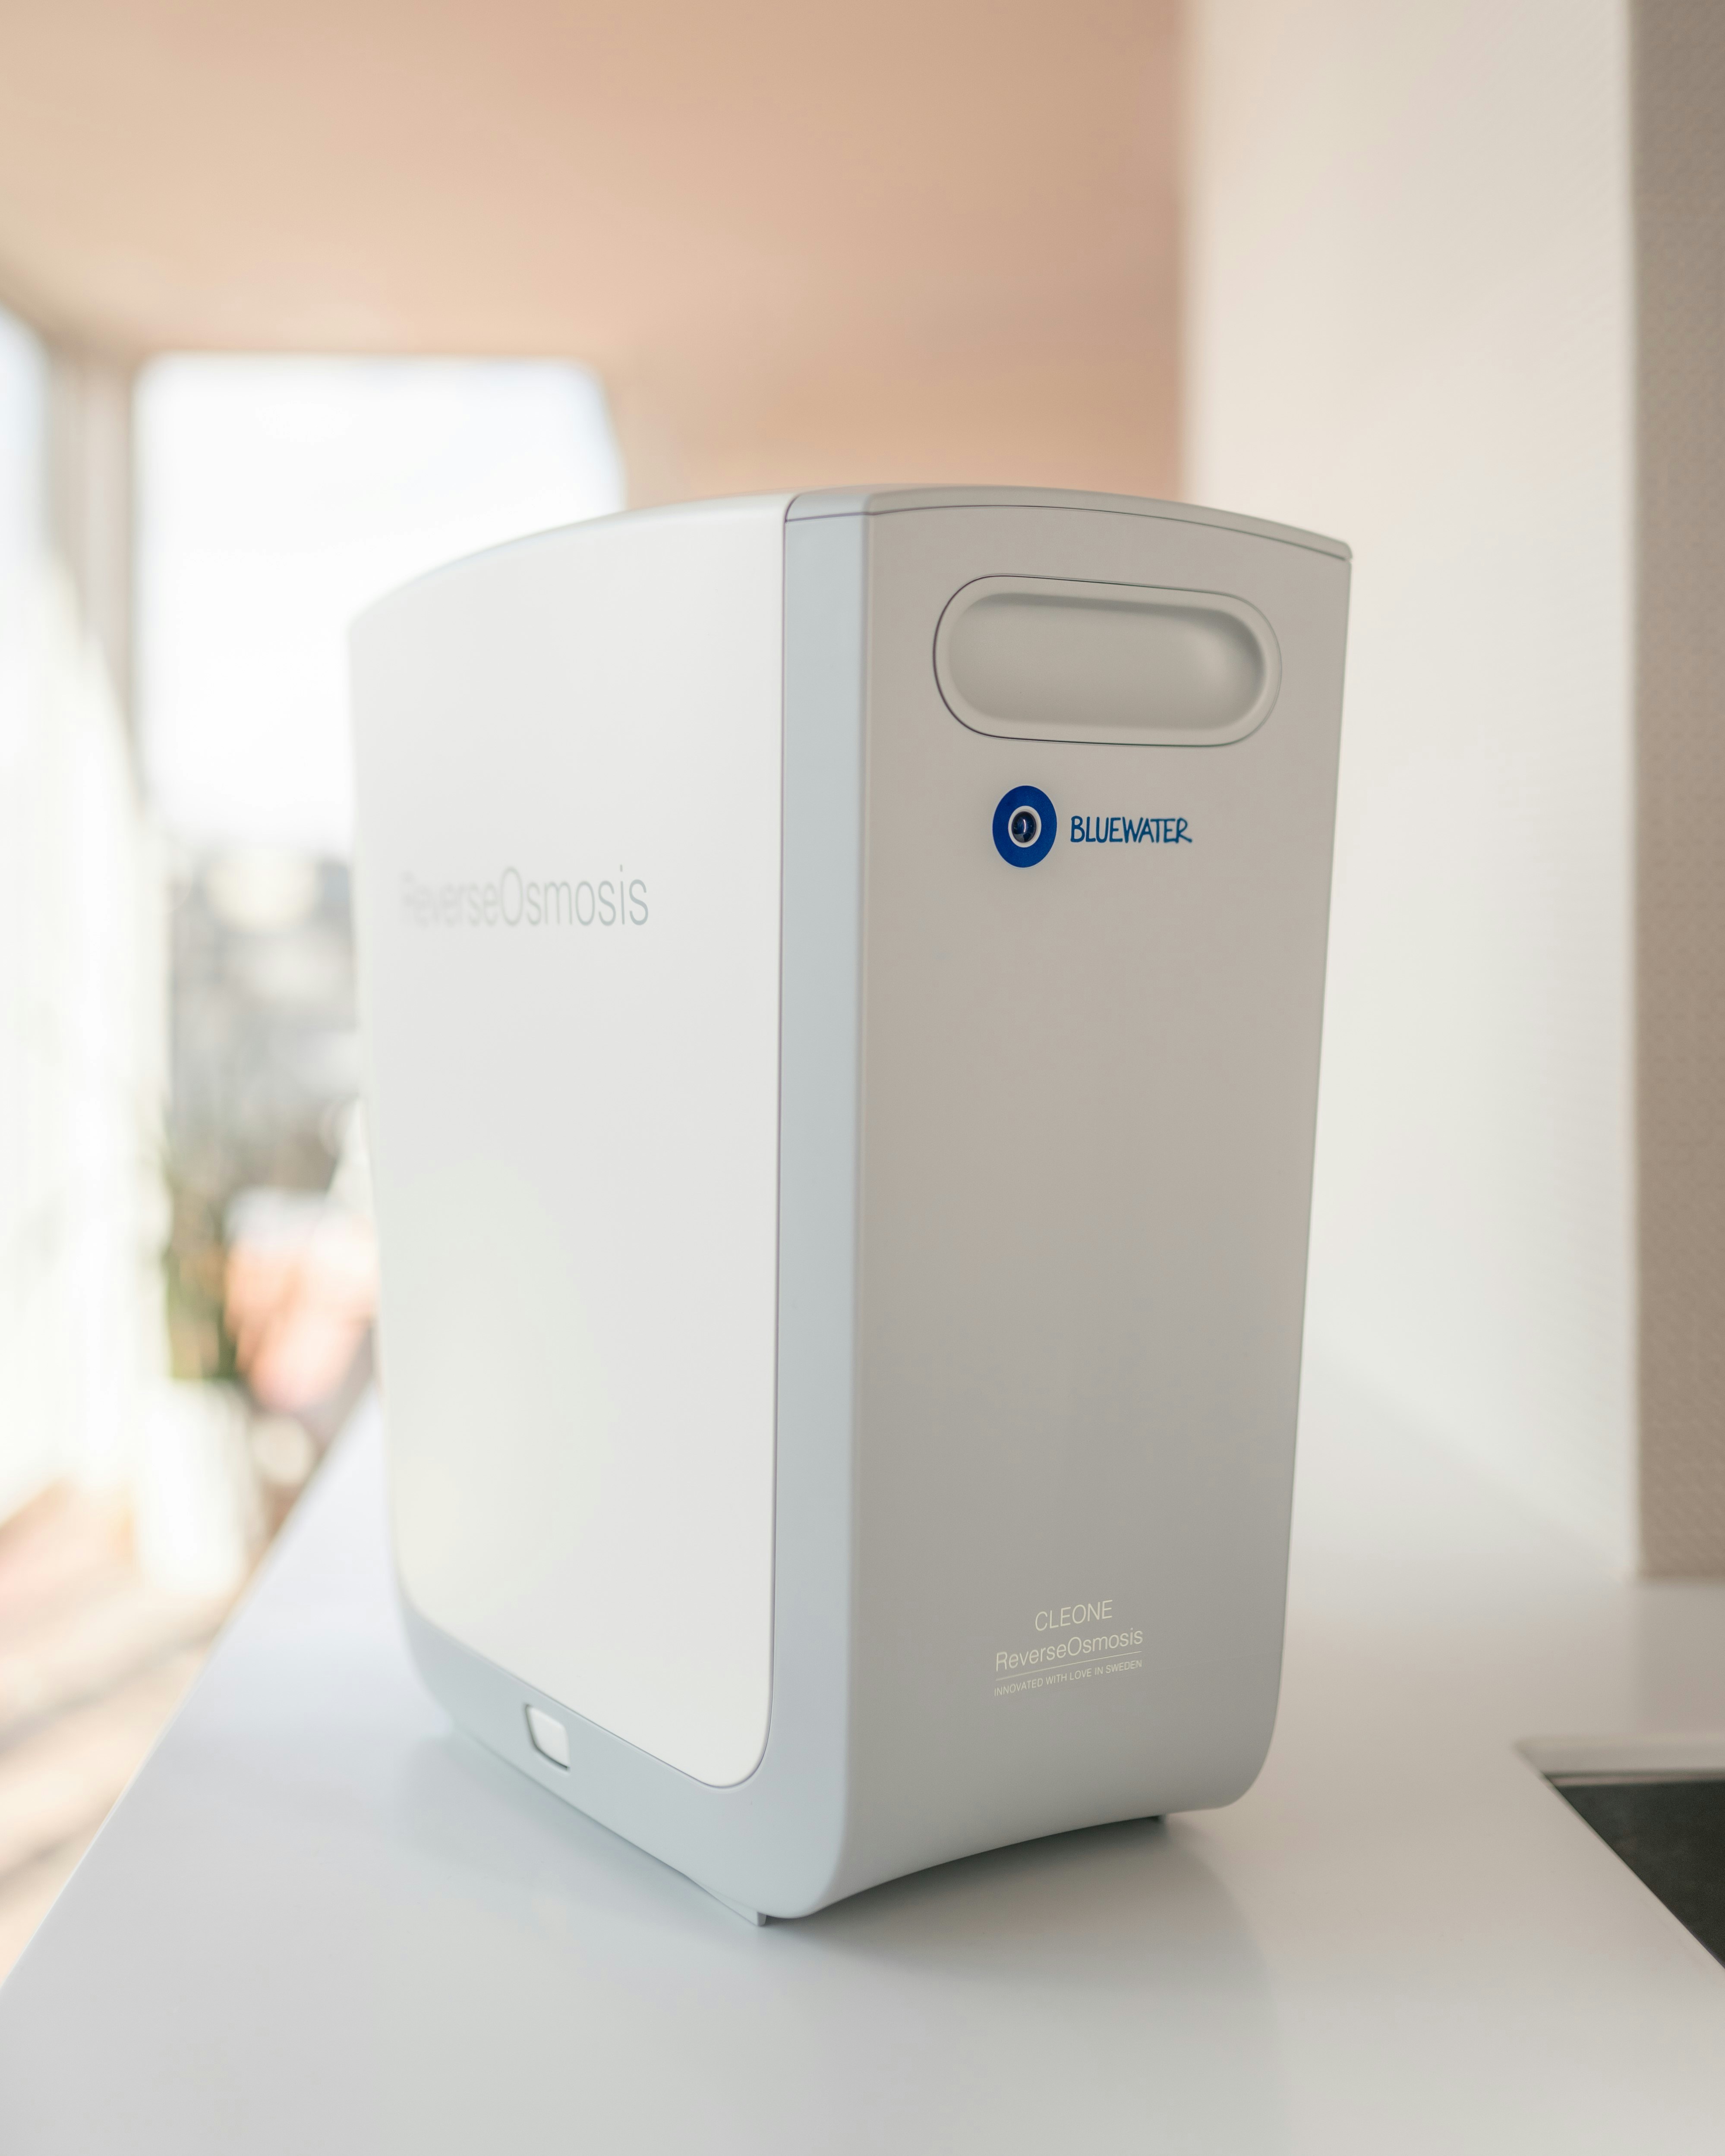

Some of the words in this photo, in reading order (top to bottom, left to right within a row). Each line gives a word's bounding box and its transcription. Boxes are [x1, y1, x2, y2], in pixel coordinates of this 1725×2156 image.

[1070, 815, 1192, 844] BLUEWATER
[1035, 1599, 1113, 1631] CLEONE
[995, 1627, 1143, 1672] ReverseOsmosis
[994, 1678, 1044, 1696] INNOVATED
[1046, 1673, 1067, 1685] WITH
[1069, 1668, 1092, 1681] LOVE
[1094, 1666, 1104, 1675] IN
[1105, 1659, 1143, 1674] SWEDEN
